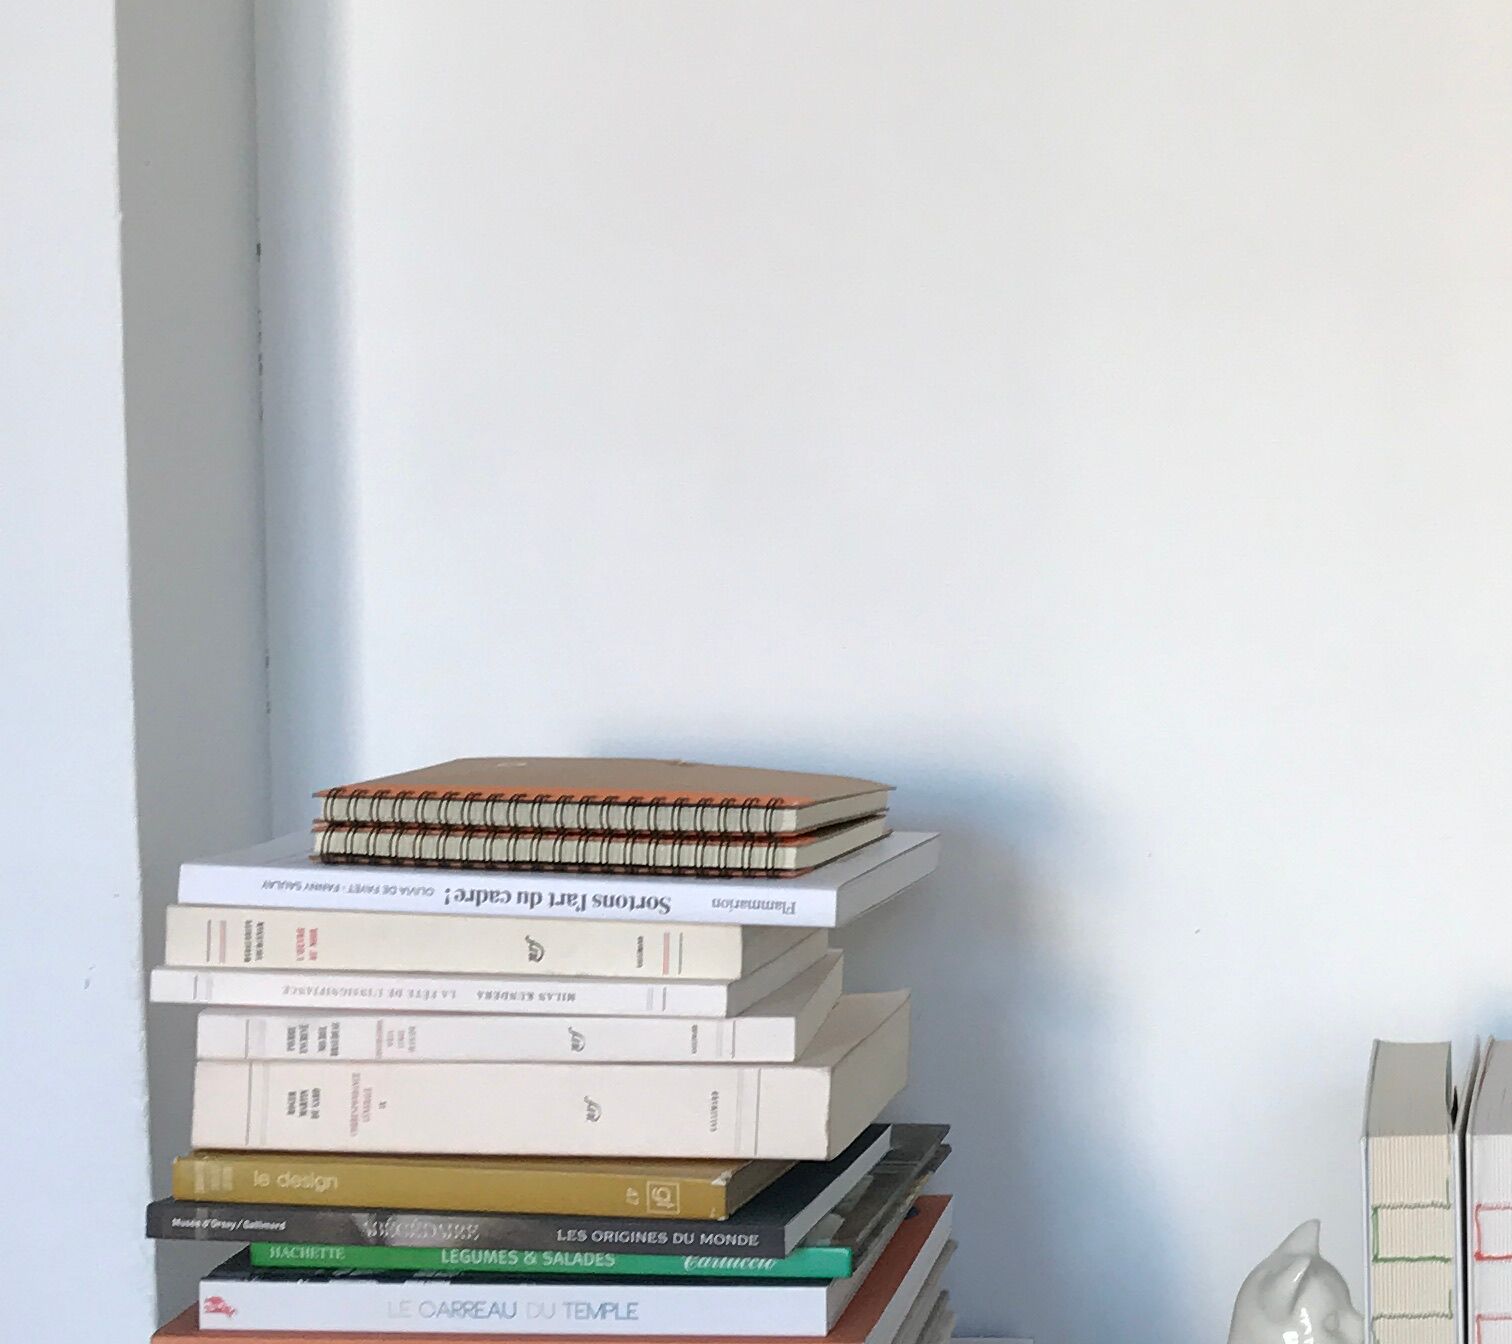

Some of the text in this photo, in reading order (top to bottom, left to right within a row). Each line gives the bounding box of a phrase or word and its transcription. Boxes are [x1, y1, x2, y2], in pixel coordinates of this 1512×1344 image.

[517, 890, 542, 911] du
[548, 891, 588, 912] l'art
[592, 891, 672, 914] Sortons
[711, 897, 796, 916] Flammarion
[253, 1170, 339, 1193] le design
[556, 1228, 760, 1247] LES ORIGINES DU MONDE
[269, 1246, 346, 1261] HACHETTE
[523, 1251, 537, 1265] &
[542, 1251, 616, 1267] SALADES
[387, 1301, 640, 1321] LE CARREAU DU TEMPLE
